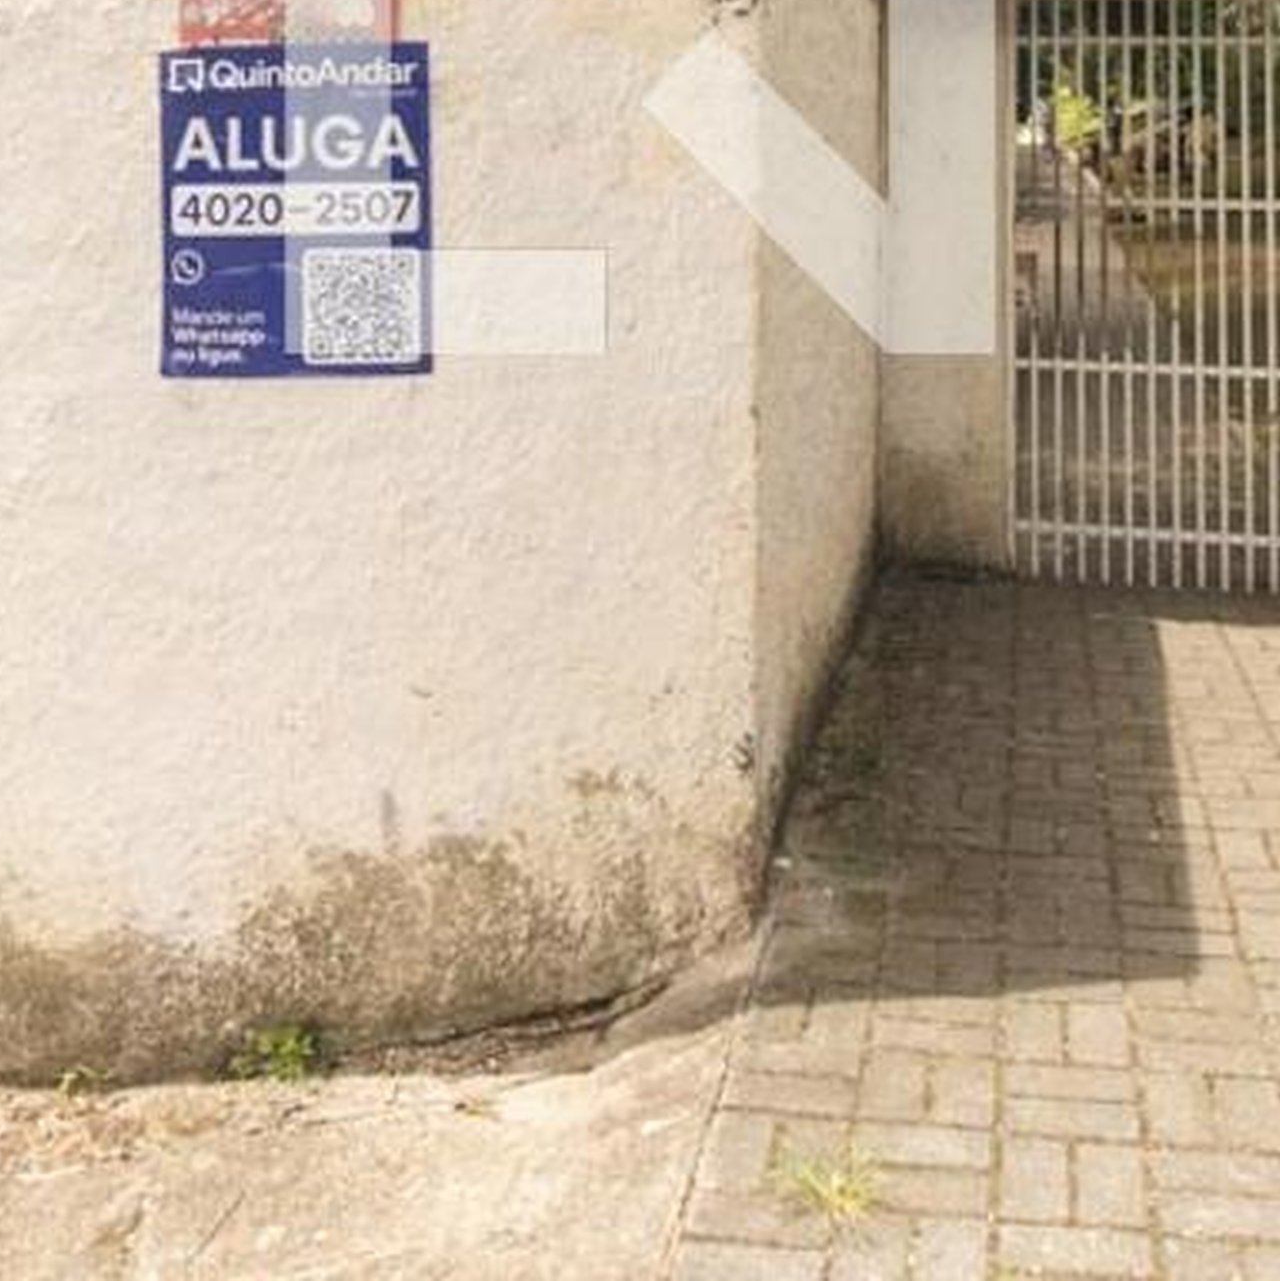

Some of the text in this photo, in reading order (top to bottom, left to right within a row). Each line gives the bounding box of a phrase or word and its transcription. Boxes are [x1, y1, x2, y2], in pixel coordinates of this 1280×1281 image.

[209, 57, 419, 90] QuintoAndar
[173, 114, 419, 171] ALUGA
[178, 189, 415, 226] 4020-2507
